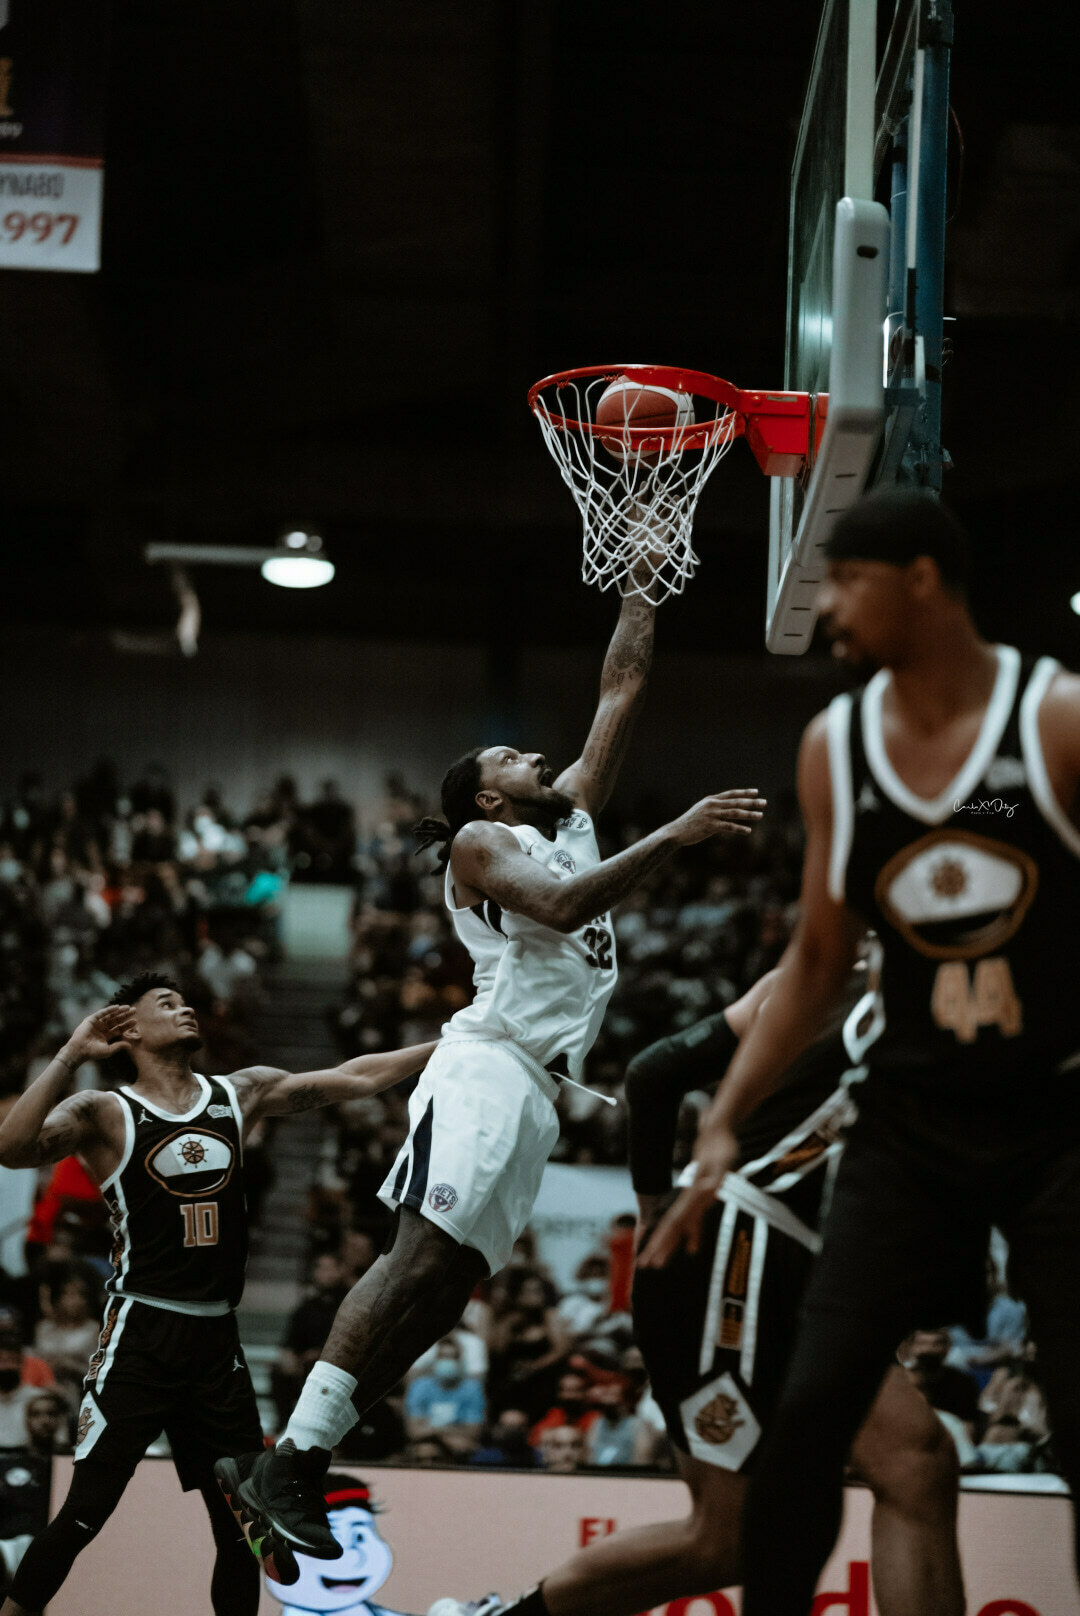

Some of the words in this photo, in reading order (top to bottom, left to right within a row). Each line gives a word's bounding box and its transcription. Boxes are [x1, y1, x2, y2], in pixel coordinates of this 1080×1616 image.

[0, 210, 80, 245] 997
[433, 1185, 456, 1206] METS
[179, 1202, 218, 1247] 10
